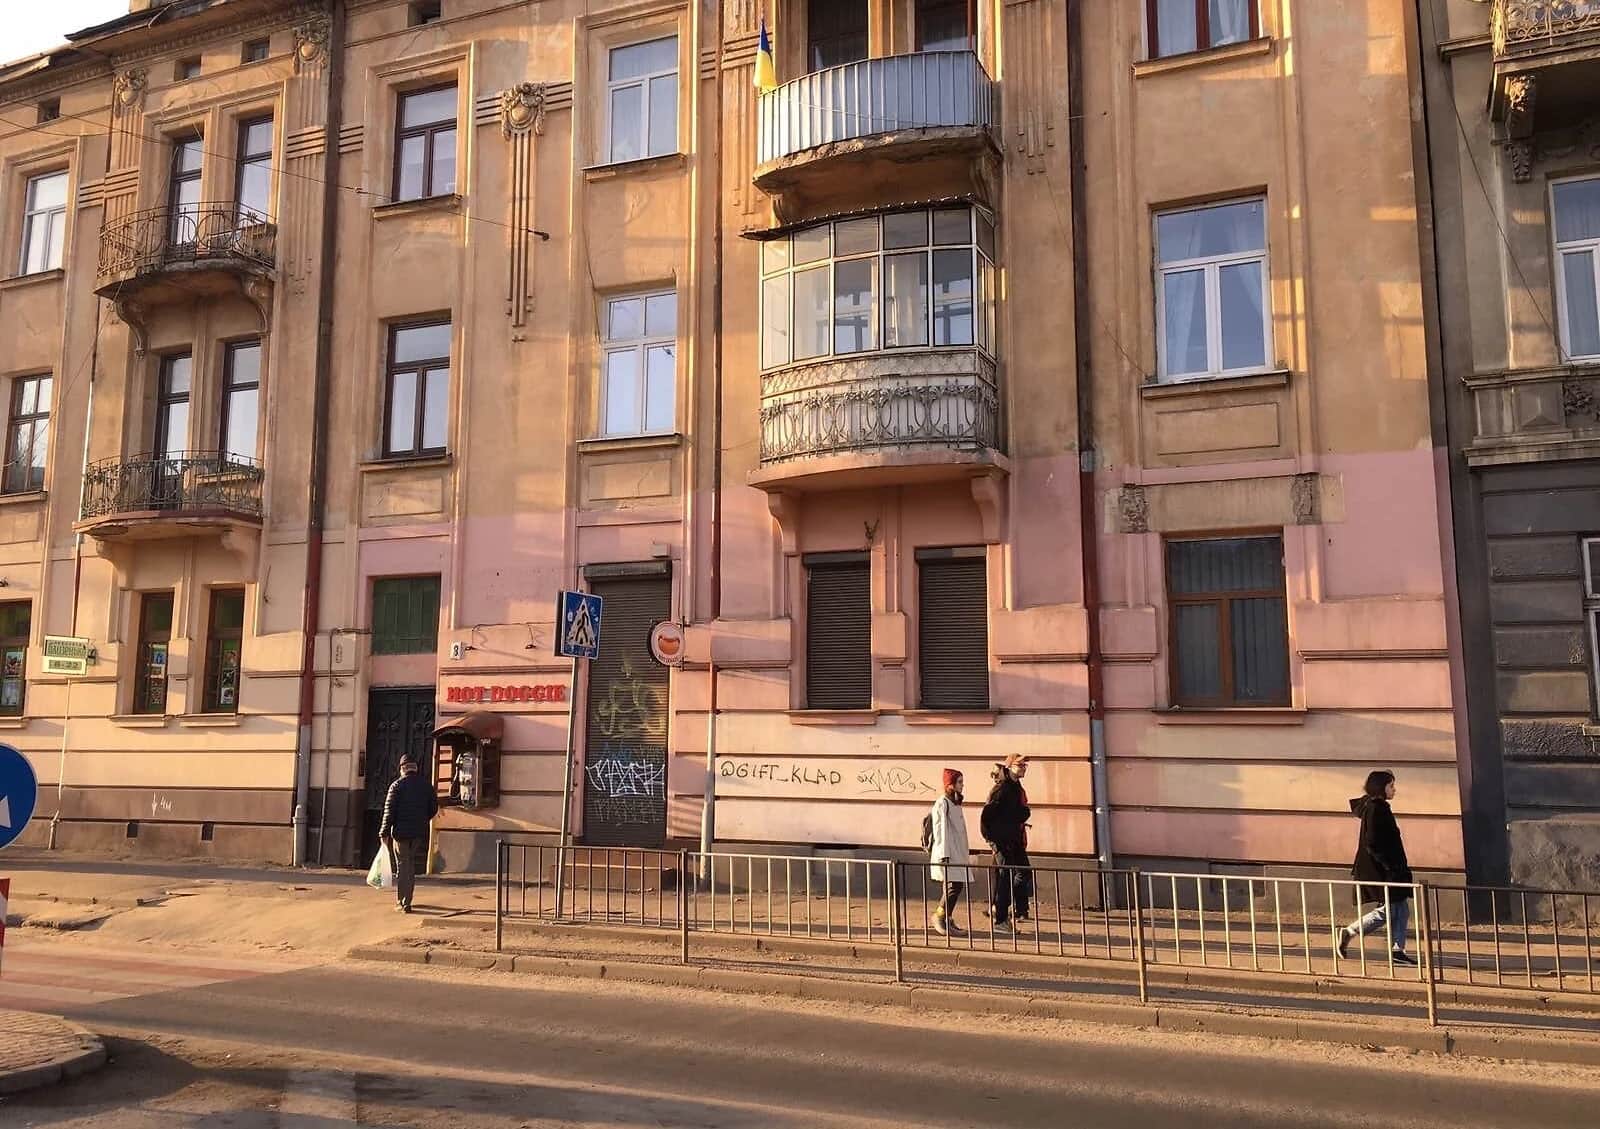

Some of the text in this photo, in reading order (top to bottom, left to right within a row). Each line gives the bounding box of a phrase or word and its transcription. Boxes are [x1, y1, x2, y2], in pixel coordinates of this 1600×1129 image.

[447, 684, 567, 703] HOT DOGGIE
[721, 760, 841, 785] @GIFT_KLAD
